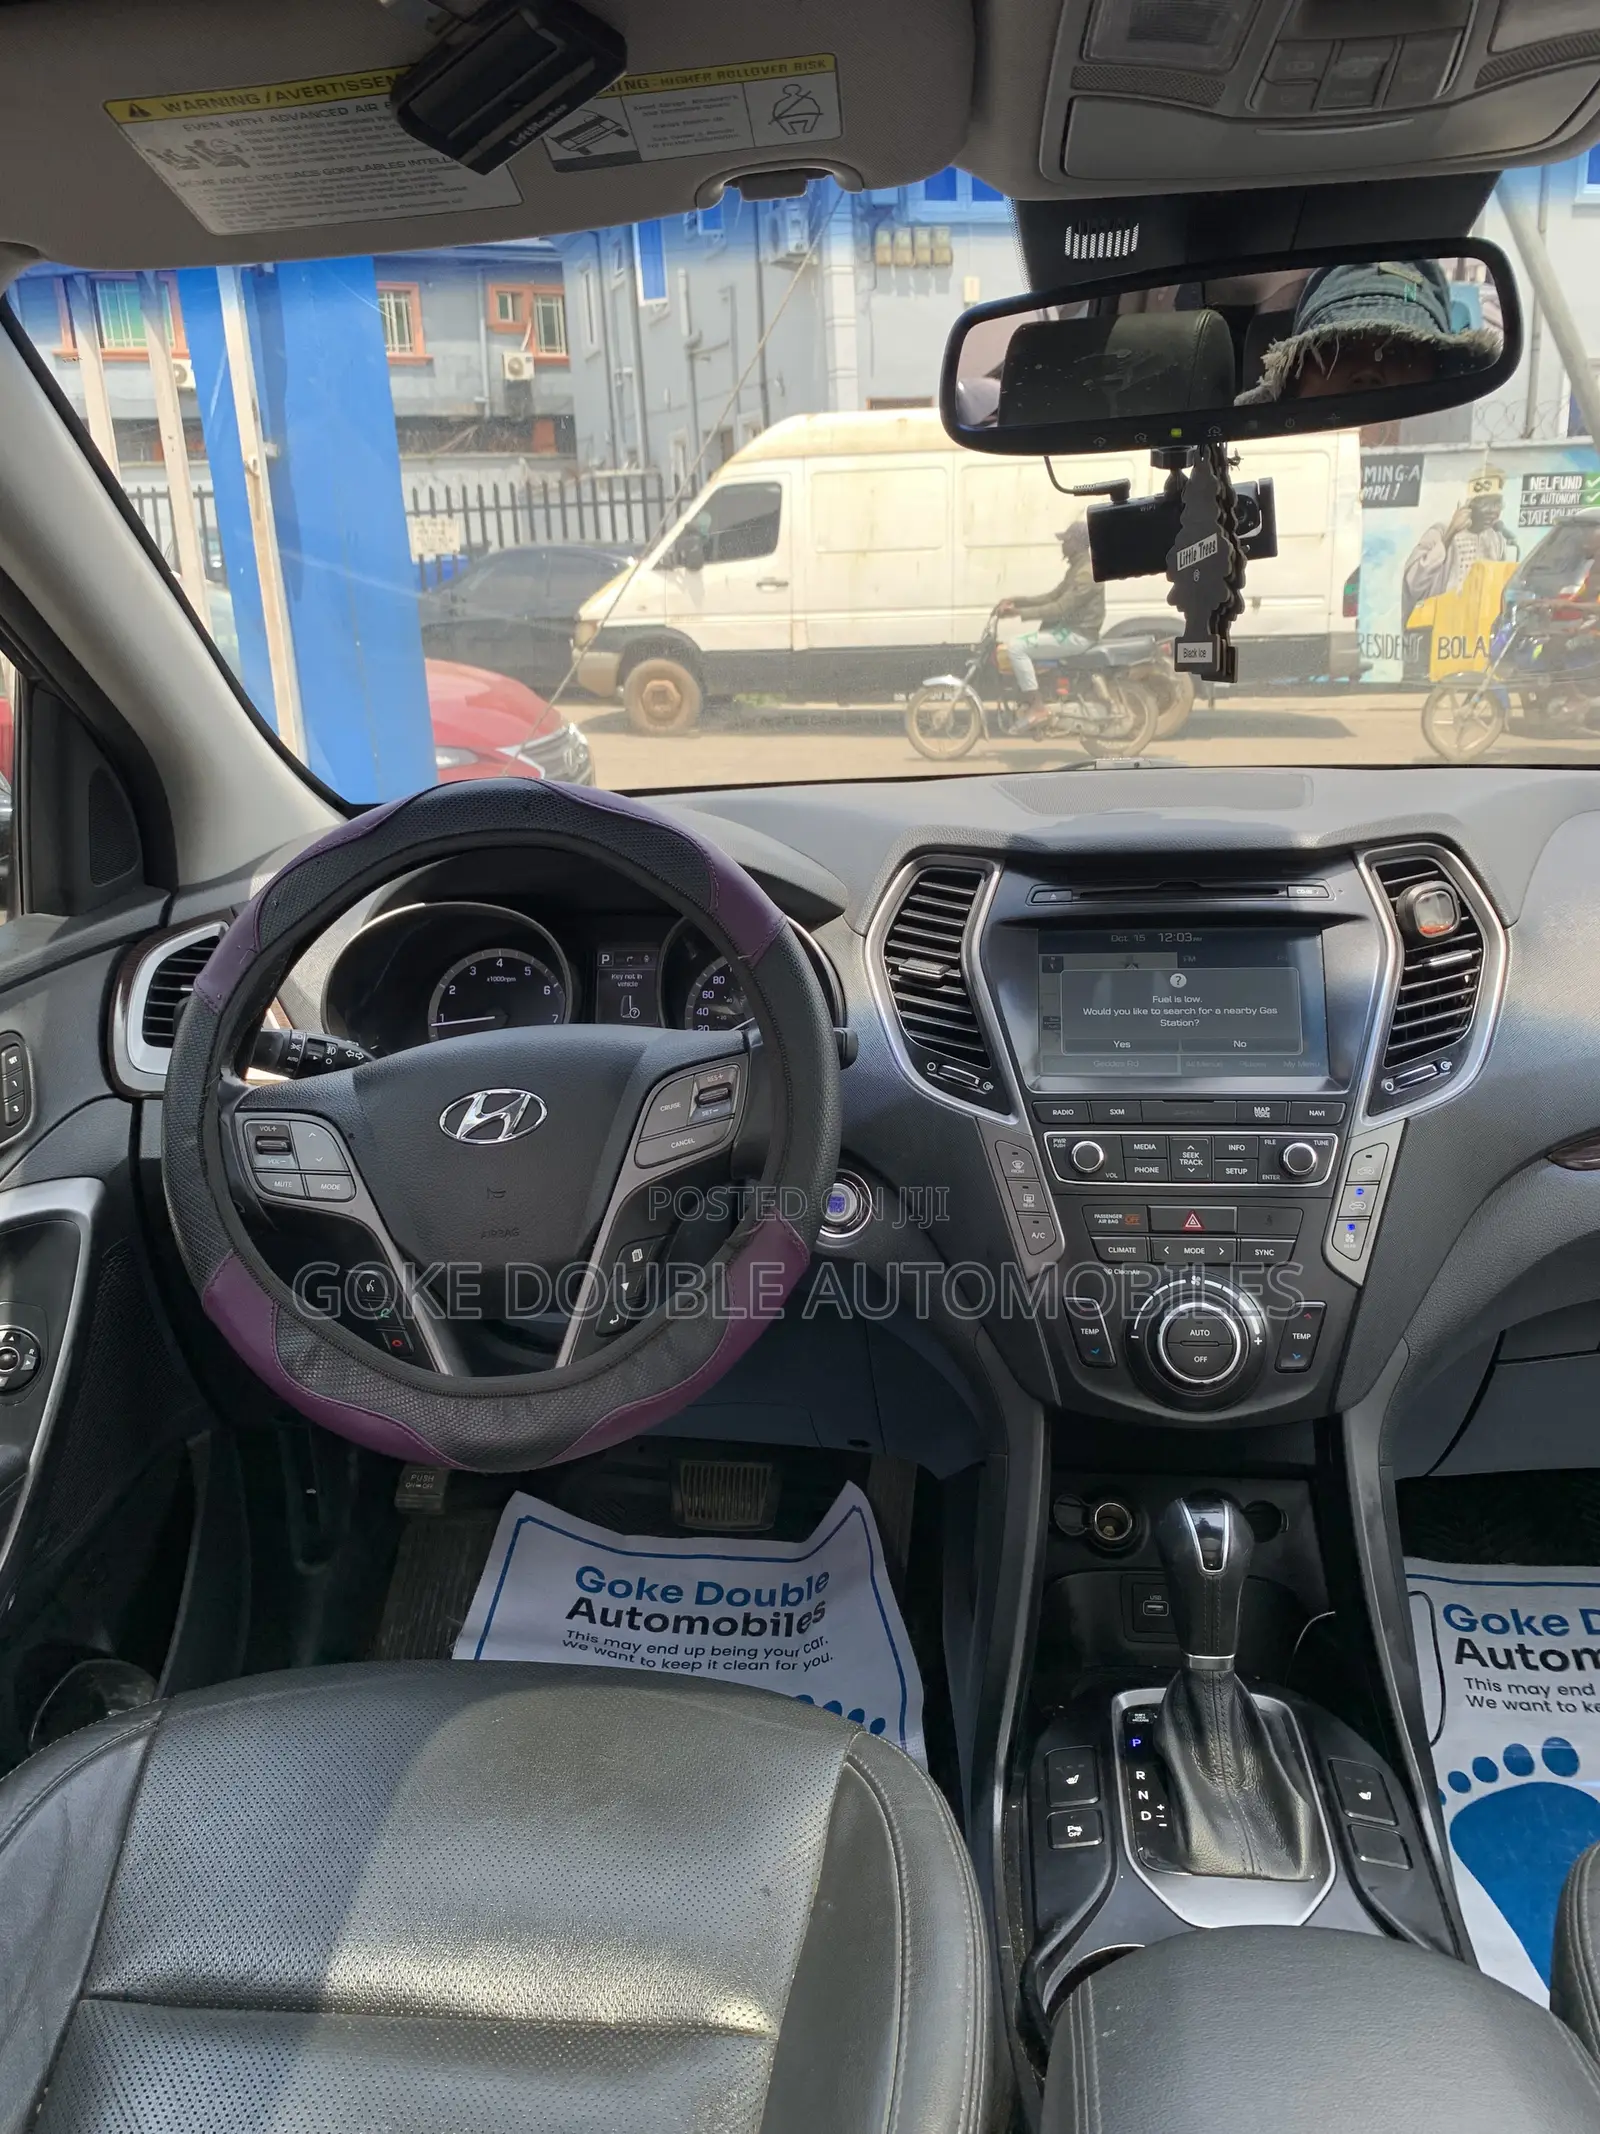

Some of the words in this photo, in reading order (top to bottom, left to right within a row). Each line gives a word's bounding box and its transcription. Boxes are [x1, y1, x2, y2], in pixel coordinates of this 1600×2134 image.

[716, 62, 787, 81] ROLLOVER
[793, 58, 826, 72] RISK
[161, 93, 261, 113] WARNING
[270, 106, 349, 123] ADVANCED
[1540, 492, 1582, 505] AUTONOMY
[1519, 508, 1549, 526] STATE
[1179, 547, 1198, 569] Little
[1198, 539, 1217, 559] Trees
[1183, 647, 1198, 659] Black
[1199, 647, 1207, 659] Ice
[1437, 635, 1490, 661] BOLA
[1134, 933, 1146, 943] 15
[496, 958, 504, 968] 4
[601, 954, 610, 965] P
[469, 966, 477, 976] 3
[524, 966, 532, 976] 5
[611, 973, 624, 982] Key
[624, 973, 636, 981] not
[636, 973, 643, 981] in
[712, 975, 726, 985] 80
[617, 980, 639, 989] vehicle
[448, 985, 456, 995] 2
[543, 985, 551, 996] 6
[701, 990, 715, 1000] 60
[1151, 995, 1173, 1004] Fuel
[1173, 995, 1182, 1004] is
[1184, 995, 1204, 1004] low.
[696, 1007, 709, 1017] 40
[1082, 1006, 1112, 1016] Would
[1113, 1007, 1131, 1018] you
[1132, 1006, 1149, 1015] like
[1150, 1006, 1162, 1016] to
[1163, 1006, 1197, 1016] search
[1197, 1006, 1213, 1016] for
[1214, 1007, 1222, 1016] a
[1223, 1006, 1258, 1018] nearby
[1258, 1006, 1278, 1016] Gas
[551, 1014, 559, 1024] 7
[1159, 1018, 1200, 1028] Station?
[697, 1024, 710, 1032] 20
[1113, 1040, 1131, 1049] Yes
[1233, 1040, 1247, 1049] No
[659, 1102, 682, 1112] CRUISE
[1109, 1108, 1126, 1116] SXM
[1253, 1106, 1271, 1114] MAP
[1308, 1109, 1326, 1117] NAVI
[670, 1138, 696, 1149] CANCEL
[1133, 1143, 1157, 1151] MEDIA
[1264, 1138, 1277, 1146] FILE
[1313, 1139, 1329, 1147] TUNE
[1228, 1143, 1246, 1152] INFO
[1181, 1151, 1200, 1159] SEEK
[1179, 1158, 1203, 1167] TRACK
[1134, 1166, 1159, 1175] PHONE
[1225, 1167, 1248, 1176] SETUP
[273, 1180, 293, 1188] MUTE
[320, 1183, 341, 1191] MODE
[1124, 1214, 1141, 1226] OFF
[1108, 1246, 1137, 1255] CLIMATE
[1183, 1246, 1206, 1255] MODE
[1254, 1249, 1275, 1257] SYNC
[1080, 1328, 1100, 1336] TEMP
[1189, 1329, 1211, 1337] AUTO
[1292, 1333, 1312, 1341] TEMP
[1193, 1355, 1208, 1364] OFF
[410, 1473, 435, 1483] PUSH
[575, 1564, 684, 1604] Goke
[694, 1570, 831, 1609] Double
[564, 1596, 827, 1638] Automobiles
[1442, 1602, 1570, 1637] Goke
[566, 1629, 600, 1645] This
[603, 1634, 642, 1656] may
[646, 1641, 679, 1656] end
[684, 1646, 706, 1659] up
[711, 1644, 759, 1661] being
[763, 1646, 800, 1660] your
[802, 1635, 830, 1655] car.
[562, 1637, 589, 1652] We
[594, 1646, 635, 1664] want
[640, 1655, 656, 1669] to
[661, 1657, 703, 1673] keep
[707, 1657, 719, 1671] it
[722, 1657, 771, 1671] clean
[775, 1656, 798, 1671] for
[801, 1651, 834, 1672] you.
[1454, 1636, 1600, 1673] Autom
[1463, 1676, 1502, 1692] This
[1507, 1682, 1550, 1699] may
[1557, 1682, 1595, 1697] end
[1465, 1694, 1498, 1709] We
[1502, 1698, 1552, 1713] want
[1557, 1700, 1578, 1714] to
[1131, 1738, 1142, 1748] P
[1135, 1770, 1146, 1781] R
[1137, 1790, 1149, 1801] N
[1140, 1810, 1152, 1821] D
